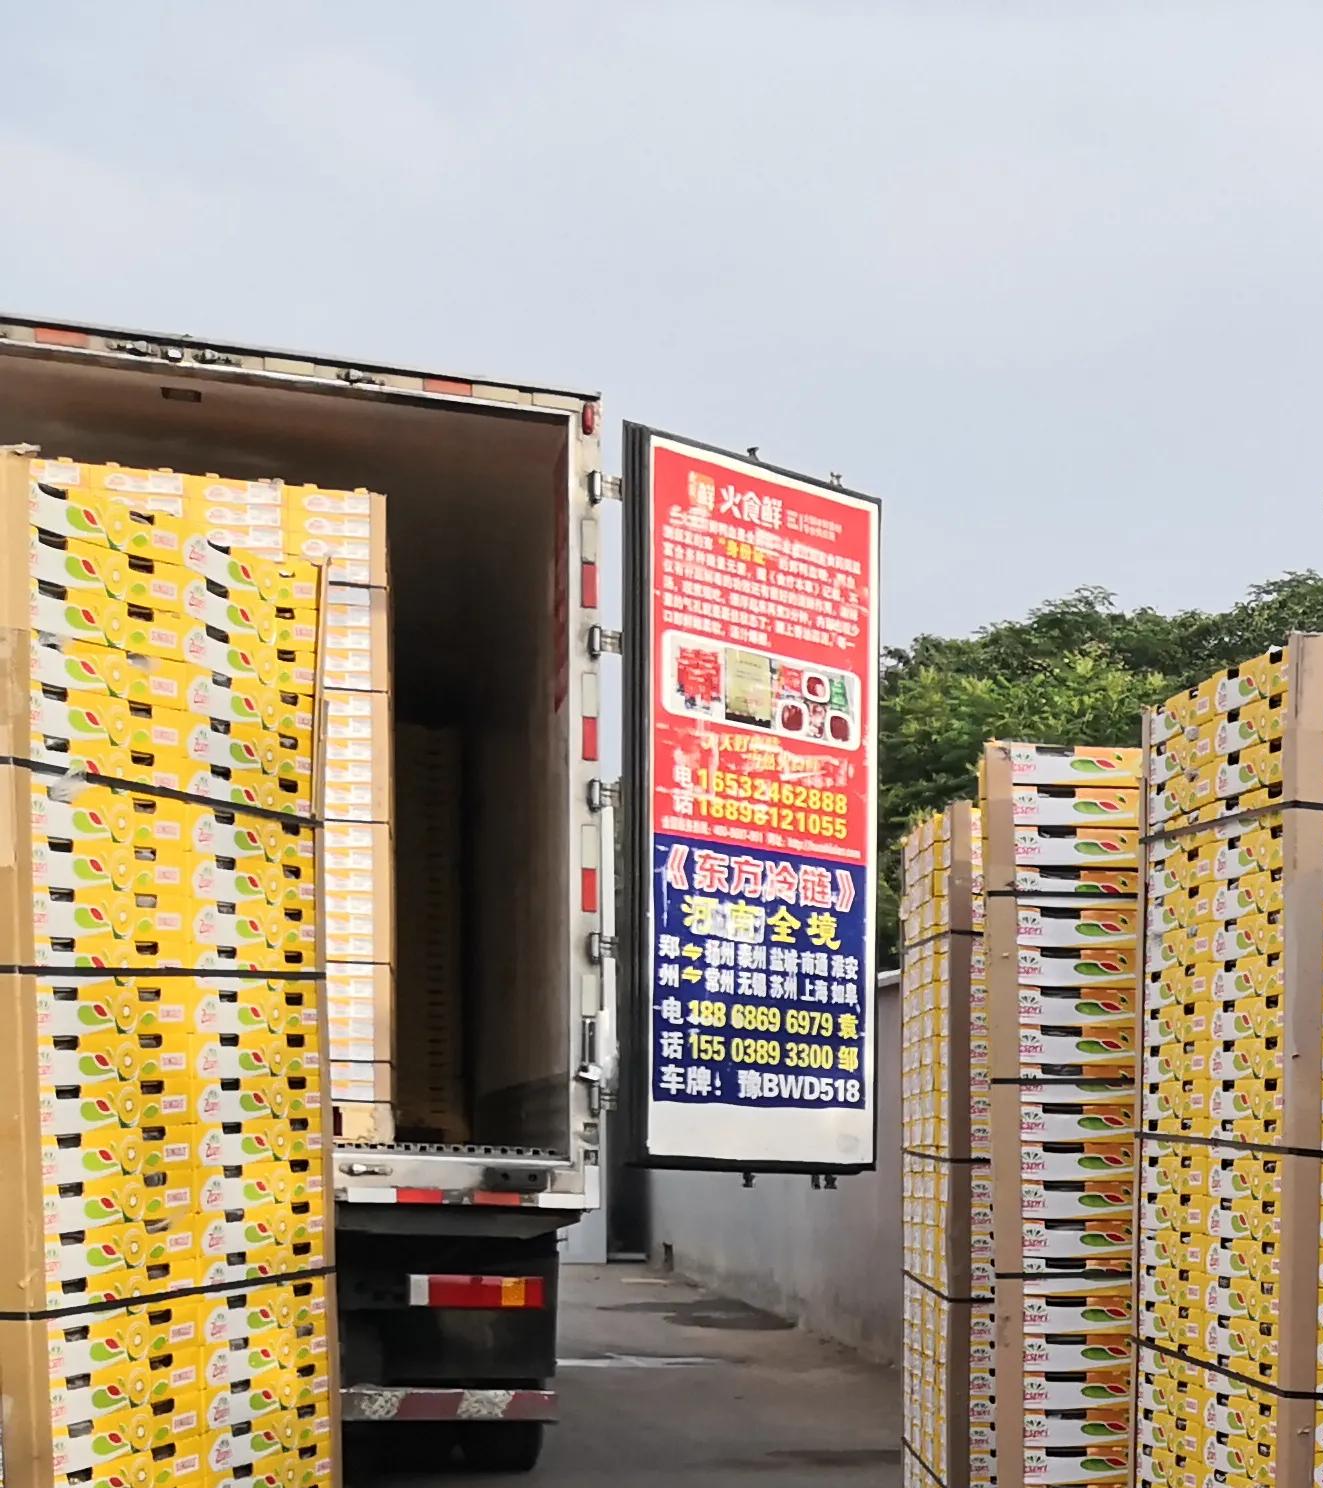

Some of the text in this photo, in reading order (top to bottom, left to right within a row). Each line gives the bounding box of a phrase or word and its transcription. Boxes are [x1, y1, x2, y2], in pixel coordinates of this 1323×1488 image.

[800, 979, 828, 1004] 上海
[687, 1000, 726, 1027] 188
[731, 1004, 780, 1032] 6869
[786, 1009, 833, 1037] 6979
[689, 1034, 726, 1061] 155
[731, 1038, 780, 1066] 0389
[785, 1042, 833, 1070] 3300
[737, 1070, 860, 1103] 豫BWD518
